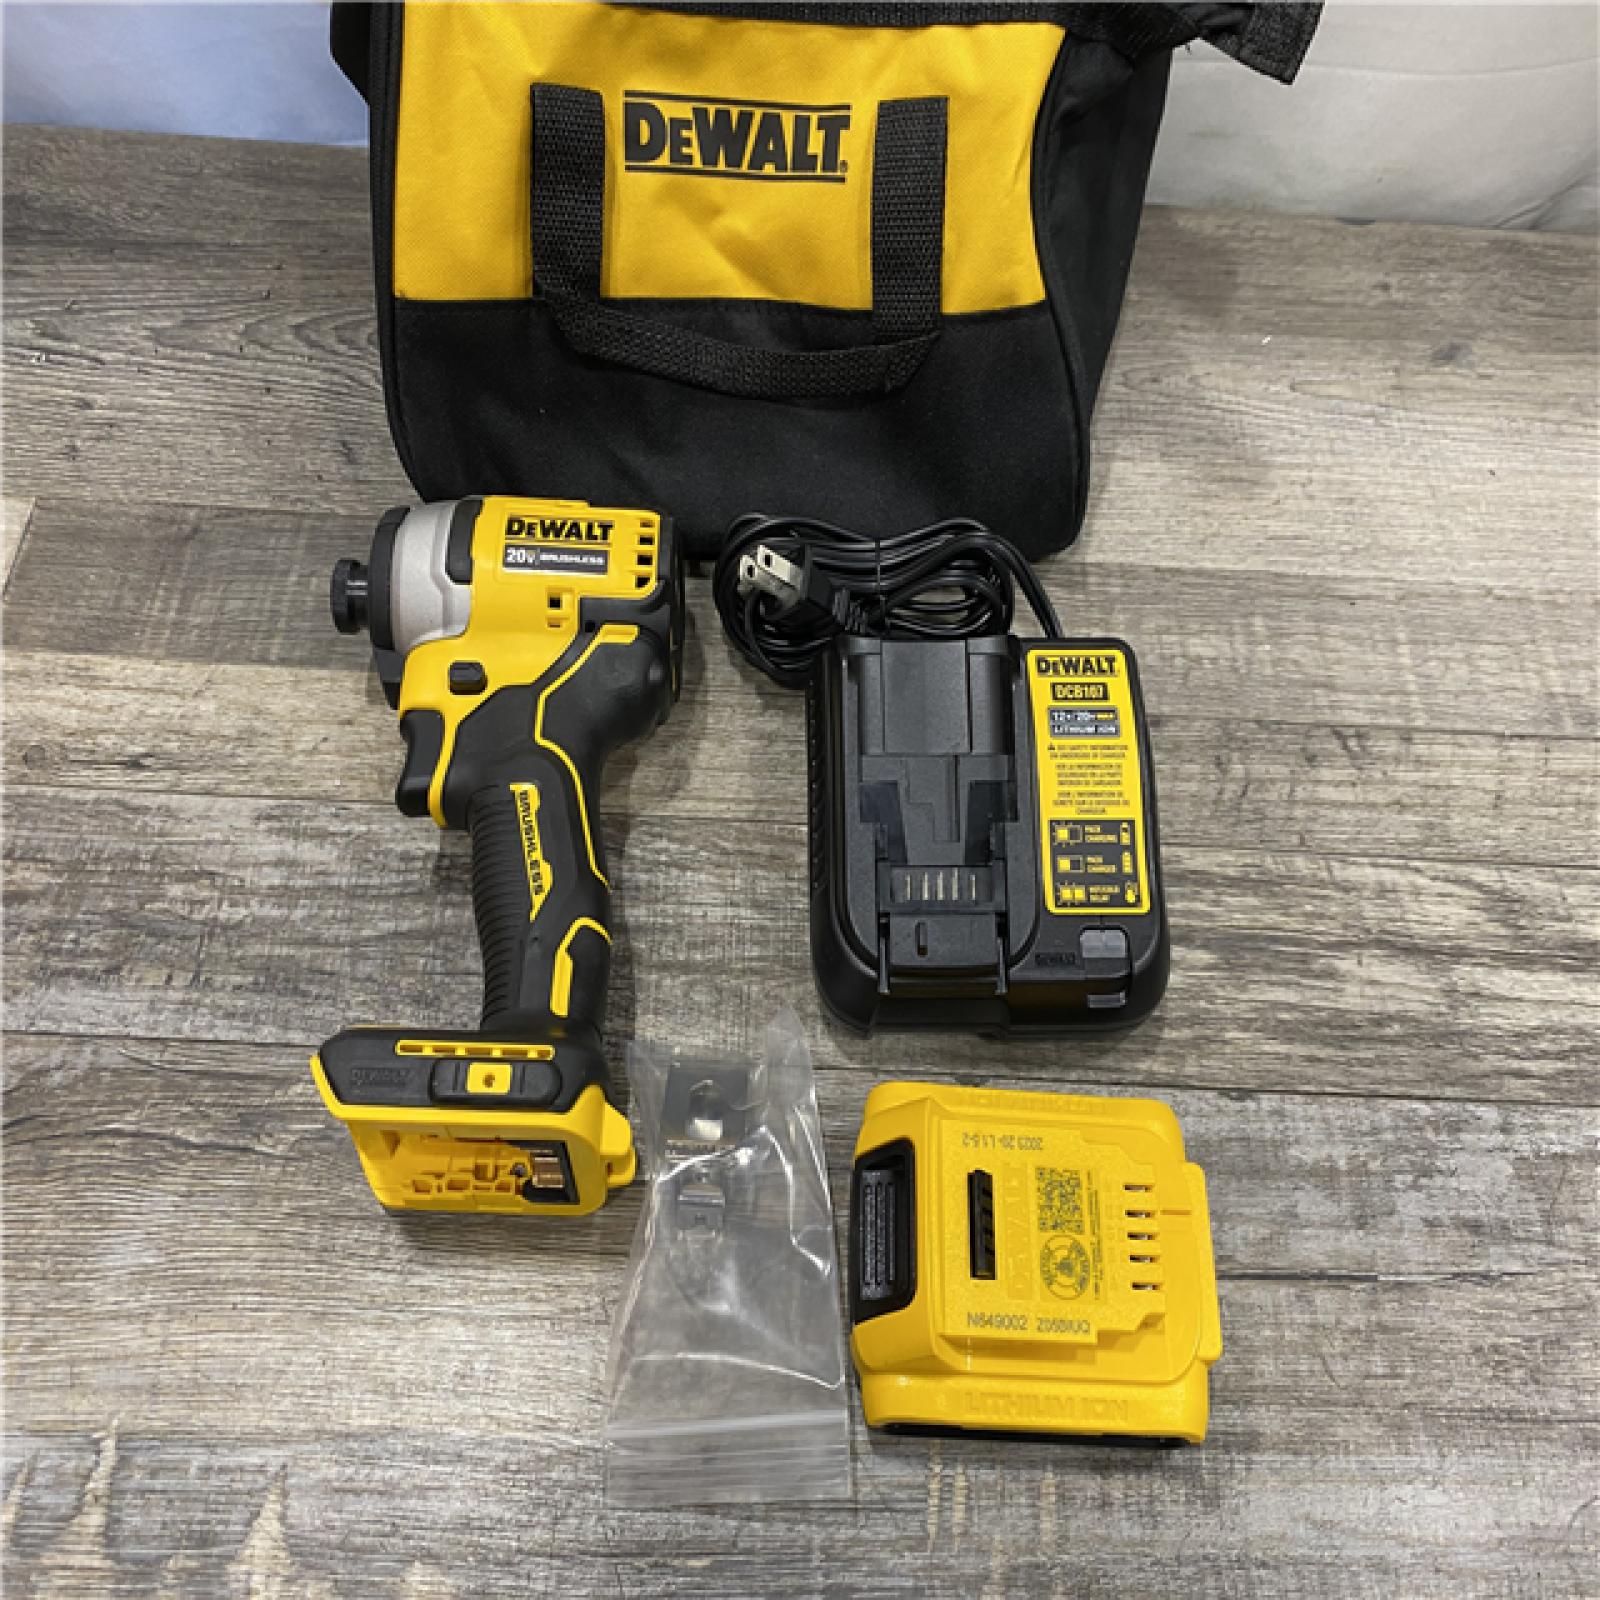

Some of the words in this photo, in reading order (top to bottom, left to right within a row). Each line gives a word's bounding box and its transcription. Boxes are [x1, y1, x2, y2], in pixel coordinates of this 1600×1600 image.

[623, 101, 851, 174] DEWALT
[506, 517, 615, 541] DEWALT
[1036, 655, 1117, 675] DEWALT
